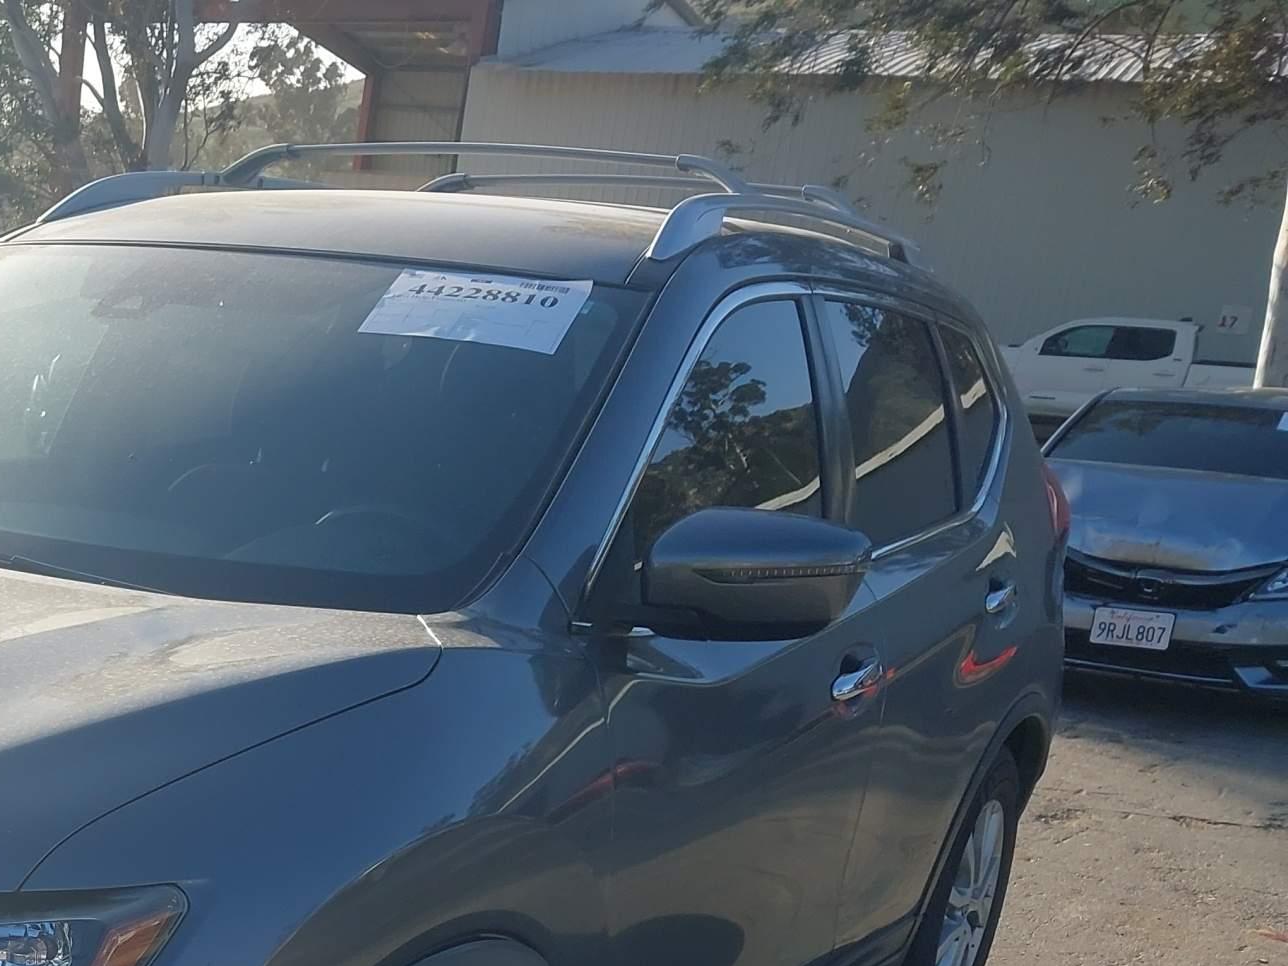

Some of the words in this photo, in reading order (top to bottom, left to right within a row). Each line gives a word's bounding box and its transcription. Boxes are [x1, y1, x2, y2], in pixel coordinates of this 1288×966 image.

[408, 283, 560, 309] 44228810
[1217, 315, 1239, 328] 17
[1096, 621, 1166, 644] 9RJL807
